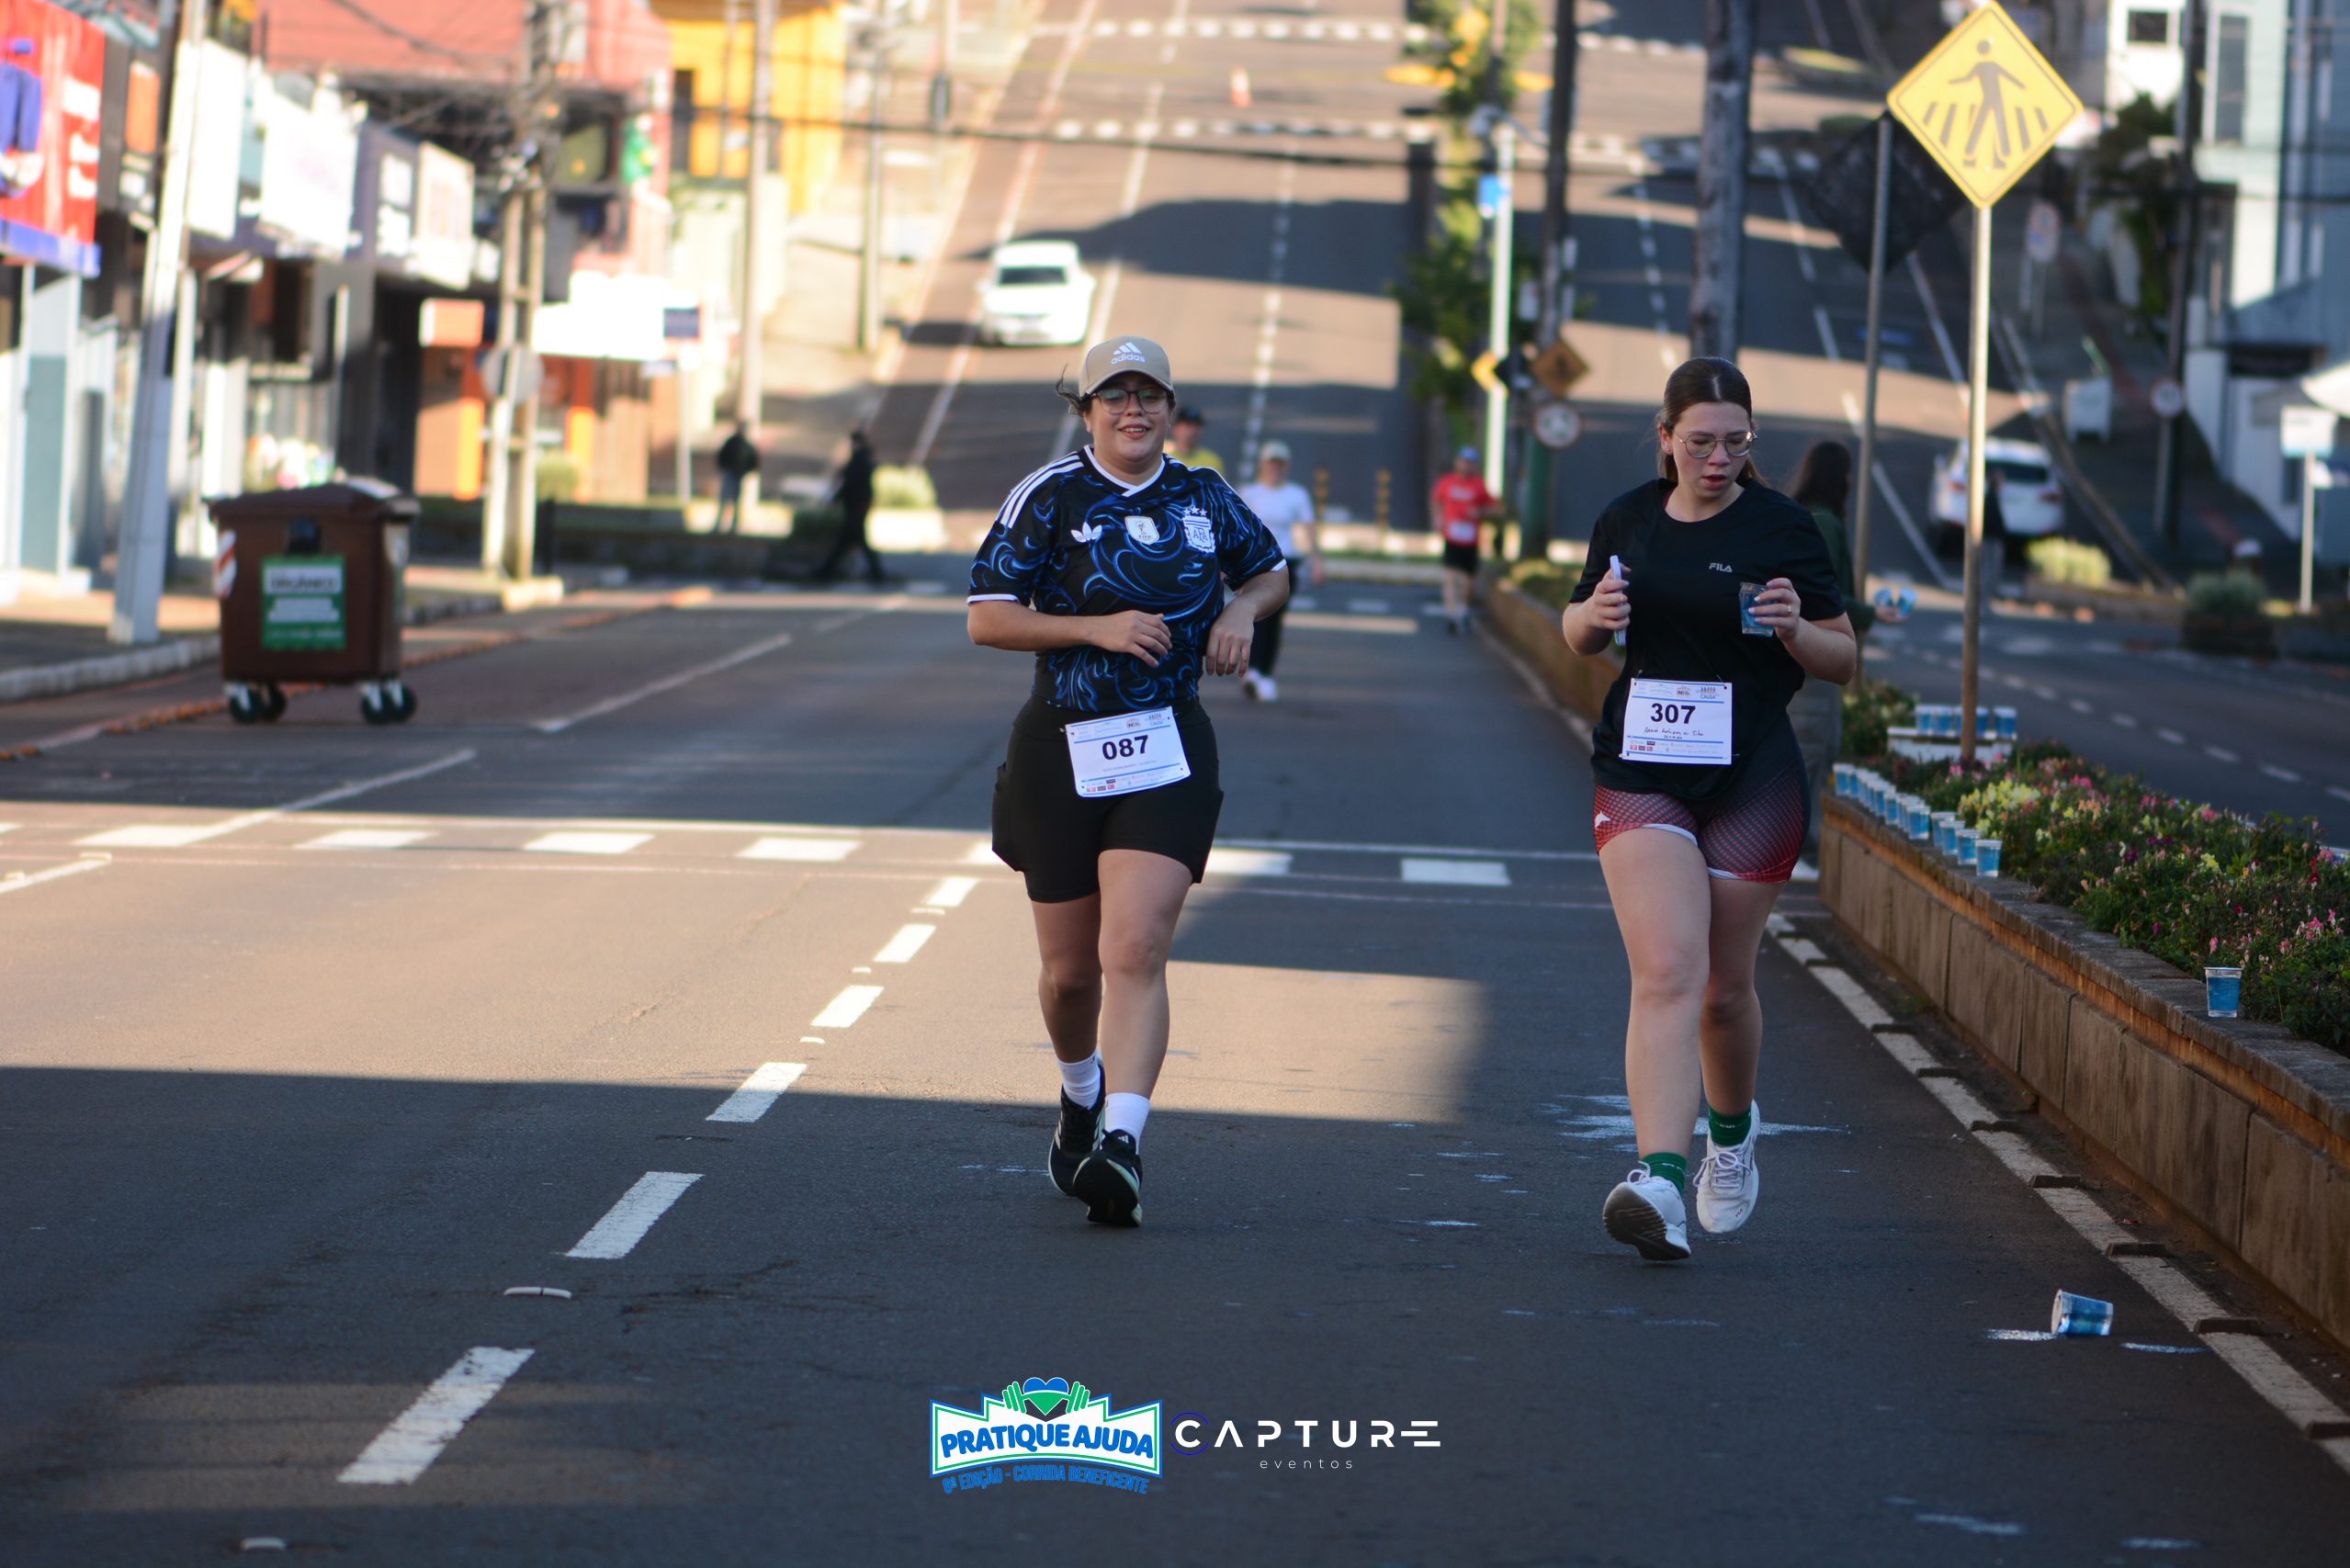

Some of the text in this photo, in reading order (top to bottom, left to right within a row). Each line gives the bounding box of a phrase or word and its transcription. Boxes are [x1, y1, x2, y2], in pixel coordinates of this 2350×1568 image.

[1111, 354, 1146, 364] adidas
[1709, 562, 1733, 573] FILA
[1650, 703, 1696, 724] 307
[1102, 735, 1148, 760] 087
